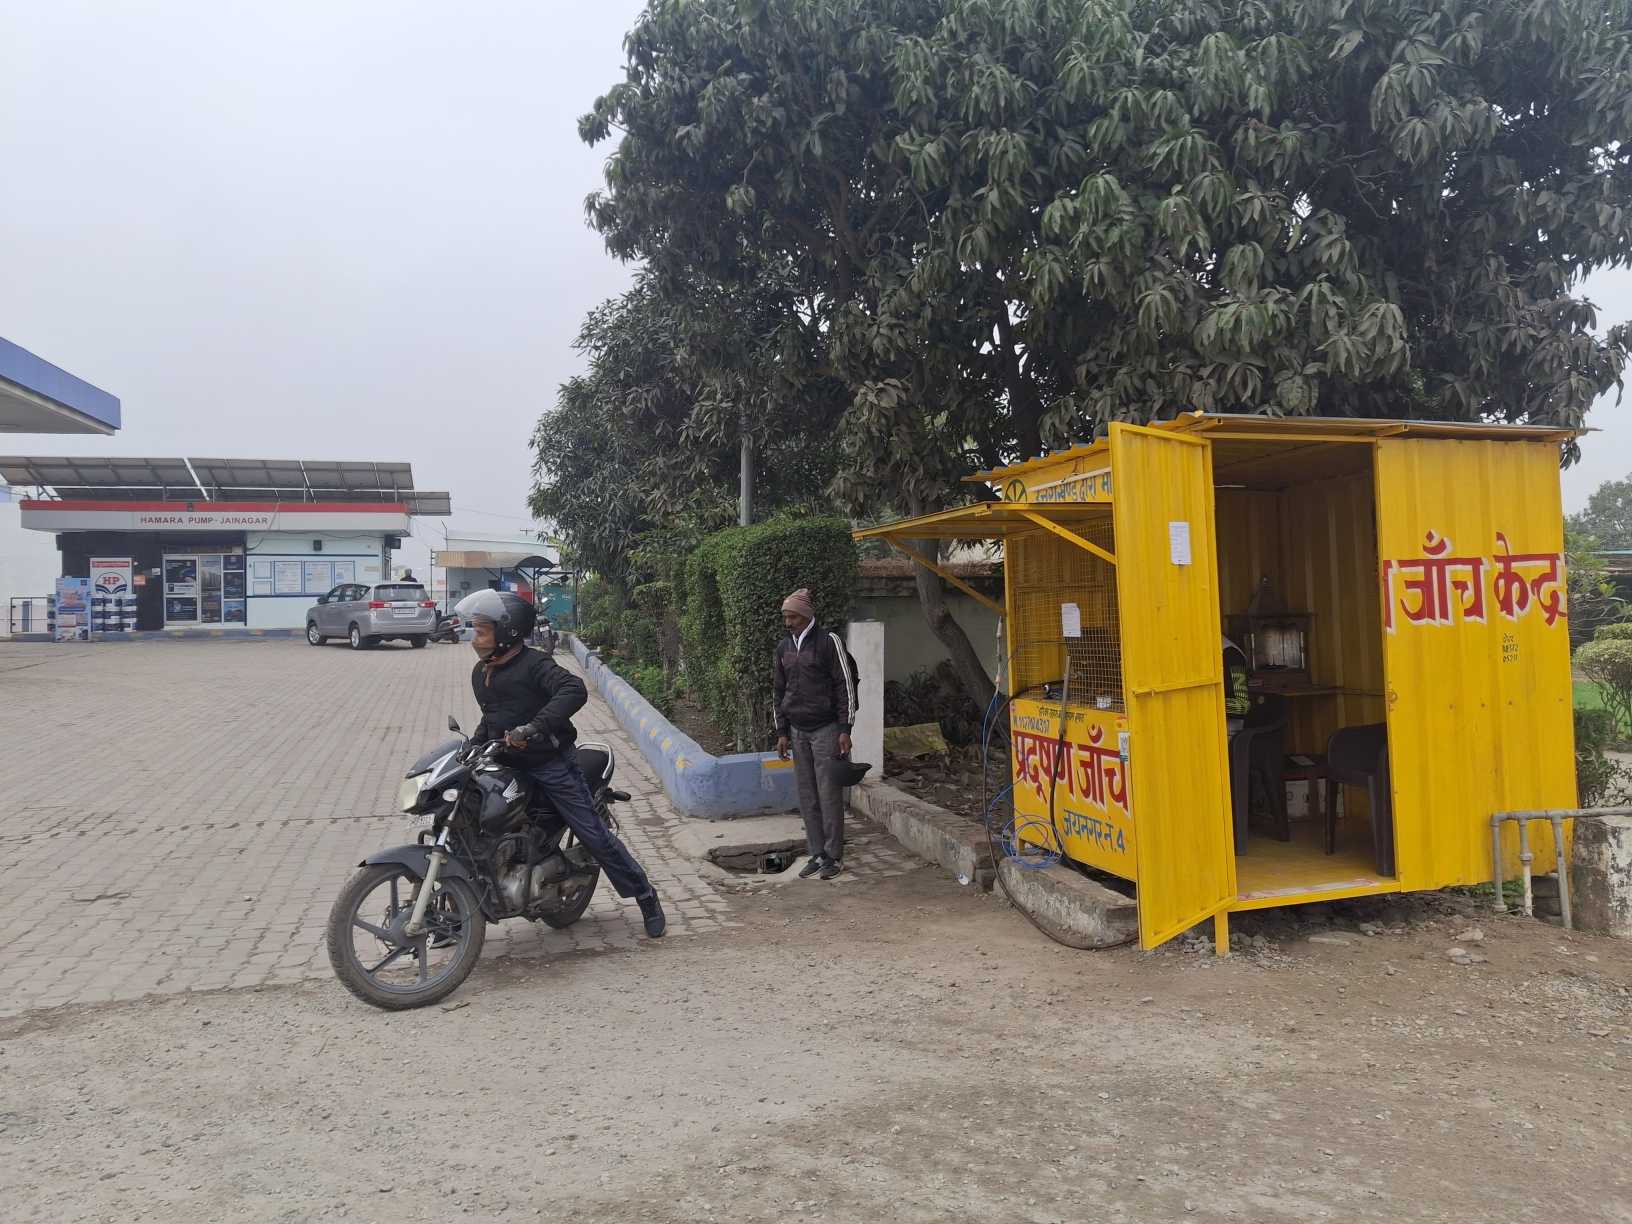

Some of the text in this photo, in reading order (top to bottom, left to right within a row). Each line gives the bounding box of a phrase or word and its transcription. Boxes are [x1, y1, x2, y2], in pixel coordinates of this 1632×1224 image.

[140, 516, 183, 525] HAMARA
[103, 576, 120, 585] HP
[1398, 530, 1484, 622] जाँच
[1012, 723, 1129, 814] प्रदूषण जाँच
